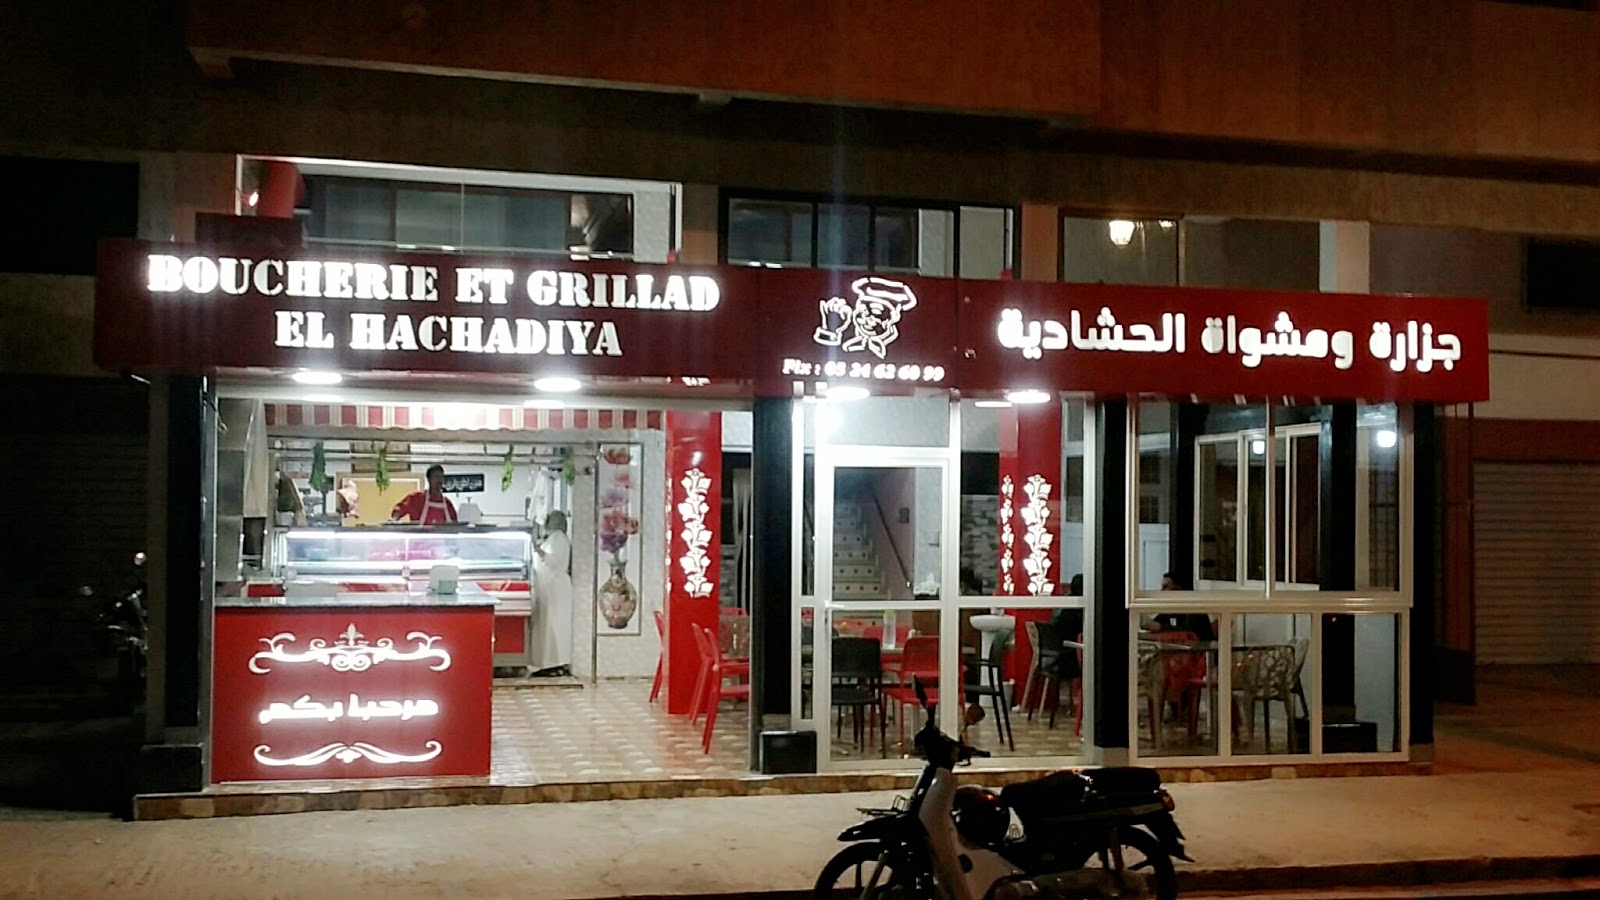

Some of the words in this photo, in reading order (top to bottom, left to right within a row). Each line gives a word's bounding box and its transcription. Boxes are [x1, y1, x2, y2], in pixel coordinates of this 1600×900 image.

[147, 254, 438, 301] BOUCHERIE
[455, 267, 514, 304] ET
[526, 270, 720, 311] GRILLAD
[275, 311, 334, 349] EL
[349, 313, 622, 356] HACHADIYA
[997, 307, 1186, 360] الحشادية
[1201, 311, 1353, 369] ومشواة
[1369, 320, 1461, 373] جزارة
[824, 361, 847, 377] 05
[849, 362, 871, 378] 24
[258, 694, 344, 724] بكم
[346, 693, 439, 721] مرحبا
